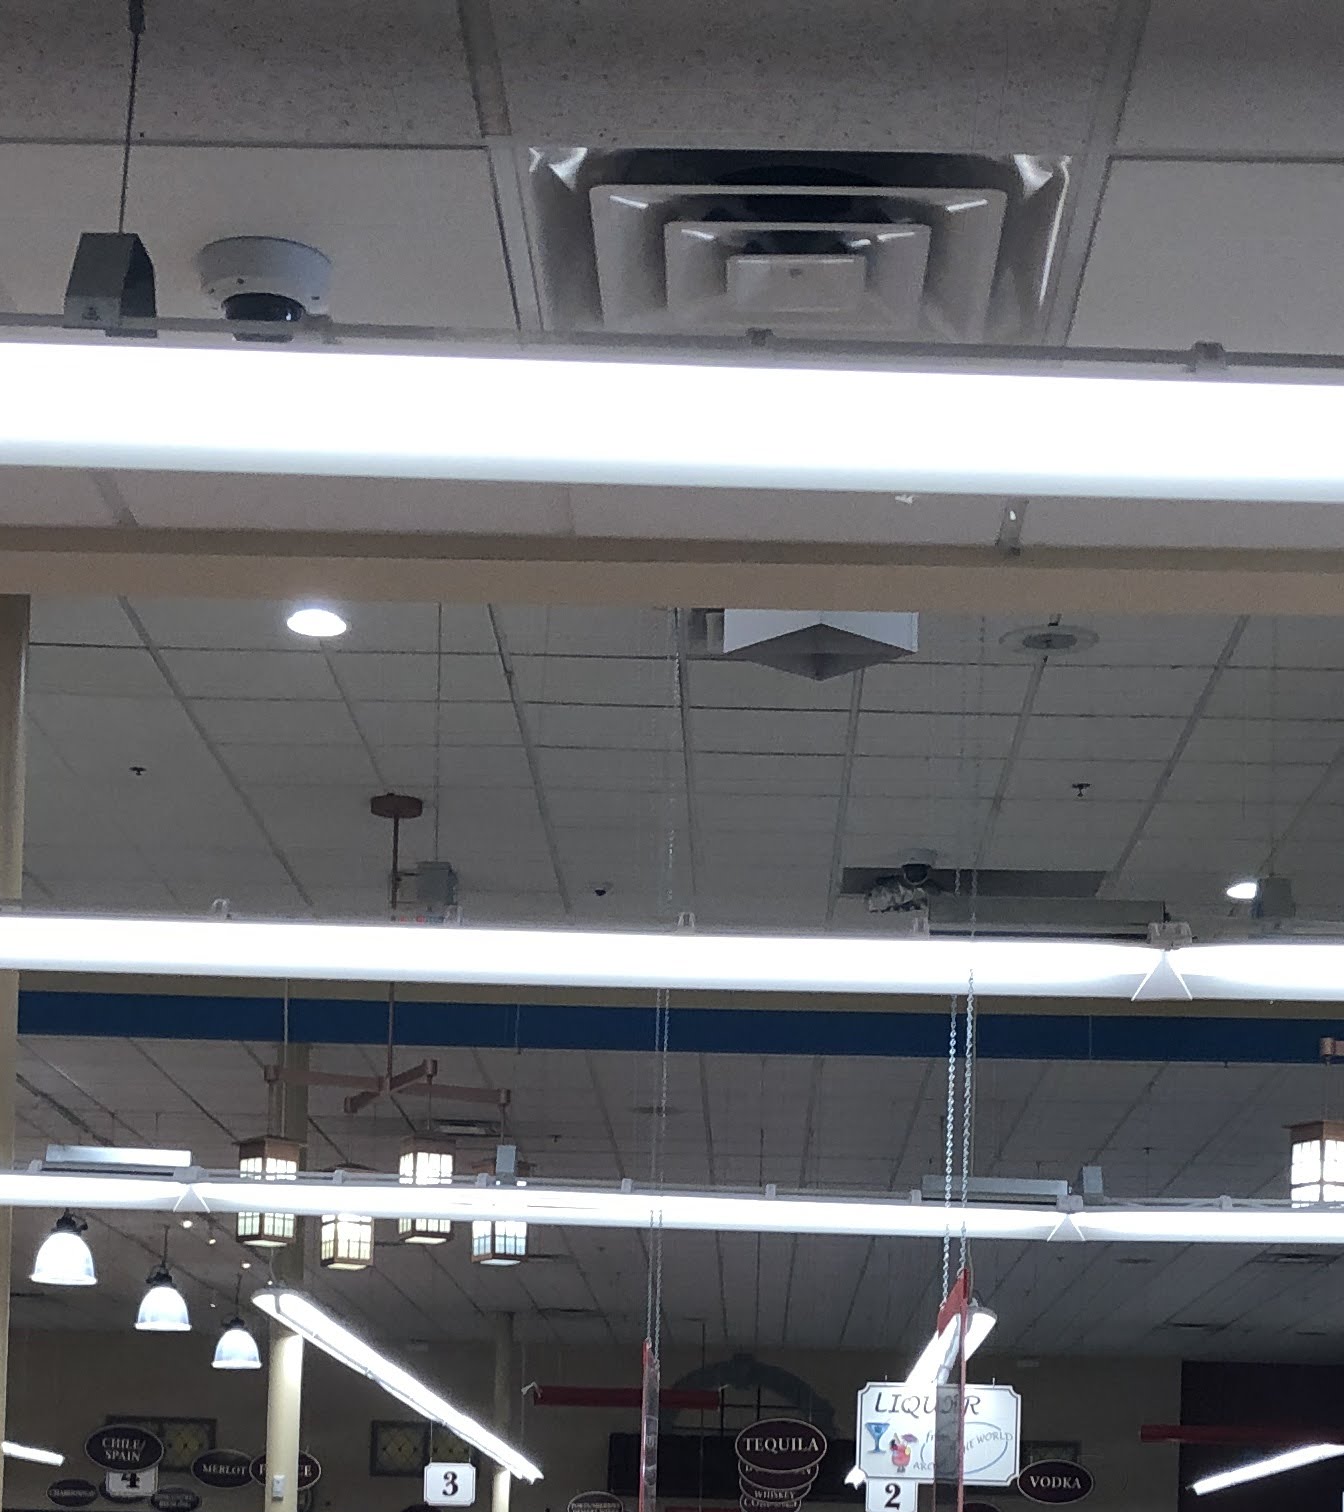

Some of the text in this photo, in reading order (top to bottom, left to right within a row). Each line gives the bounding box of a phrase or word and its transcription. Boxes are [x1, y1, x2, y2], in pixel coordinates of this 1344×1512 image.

[874, 1392, 981, 1419] LIQUOR
[743, 1437, 819, 1452] TEQUILA
[976, 1432, 1014, 1445] WORLD
[105, 1450, 140, 1462] SPAIN
[202, 1463, 247, 1476] MERLOT
[442, 1471, 458, 1497] 3
[1030, 1475, 1082, 1490] VODKA
[754, 1490, 794, 1500] WHISKEY
[884, 1483, 901, 1510] 2
